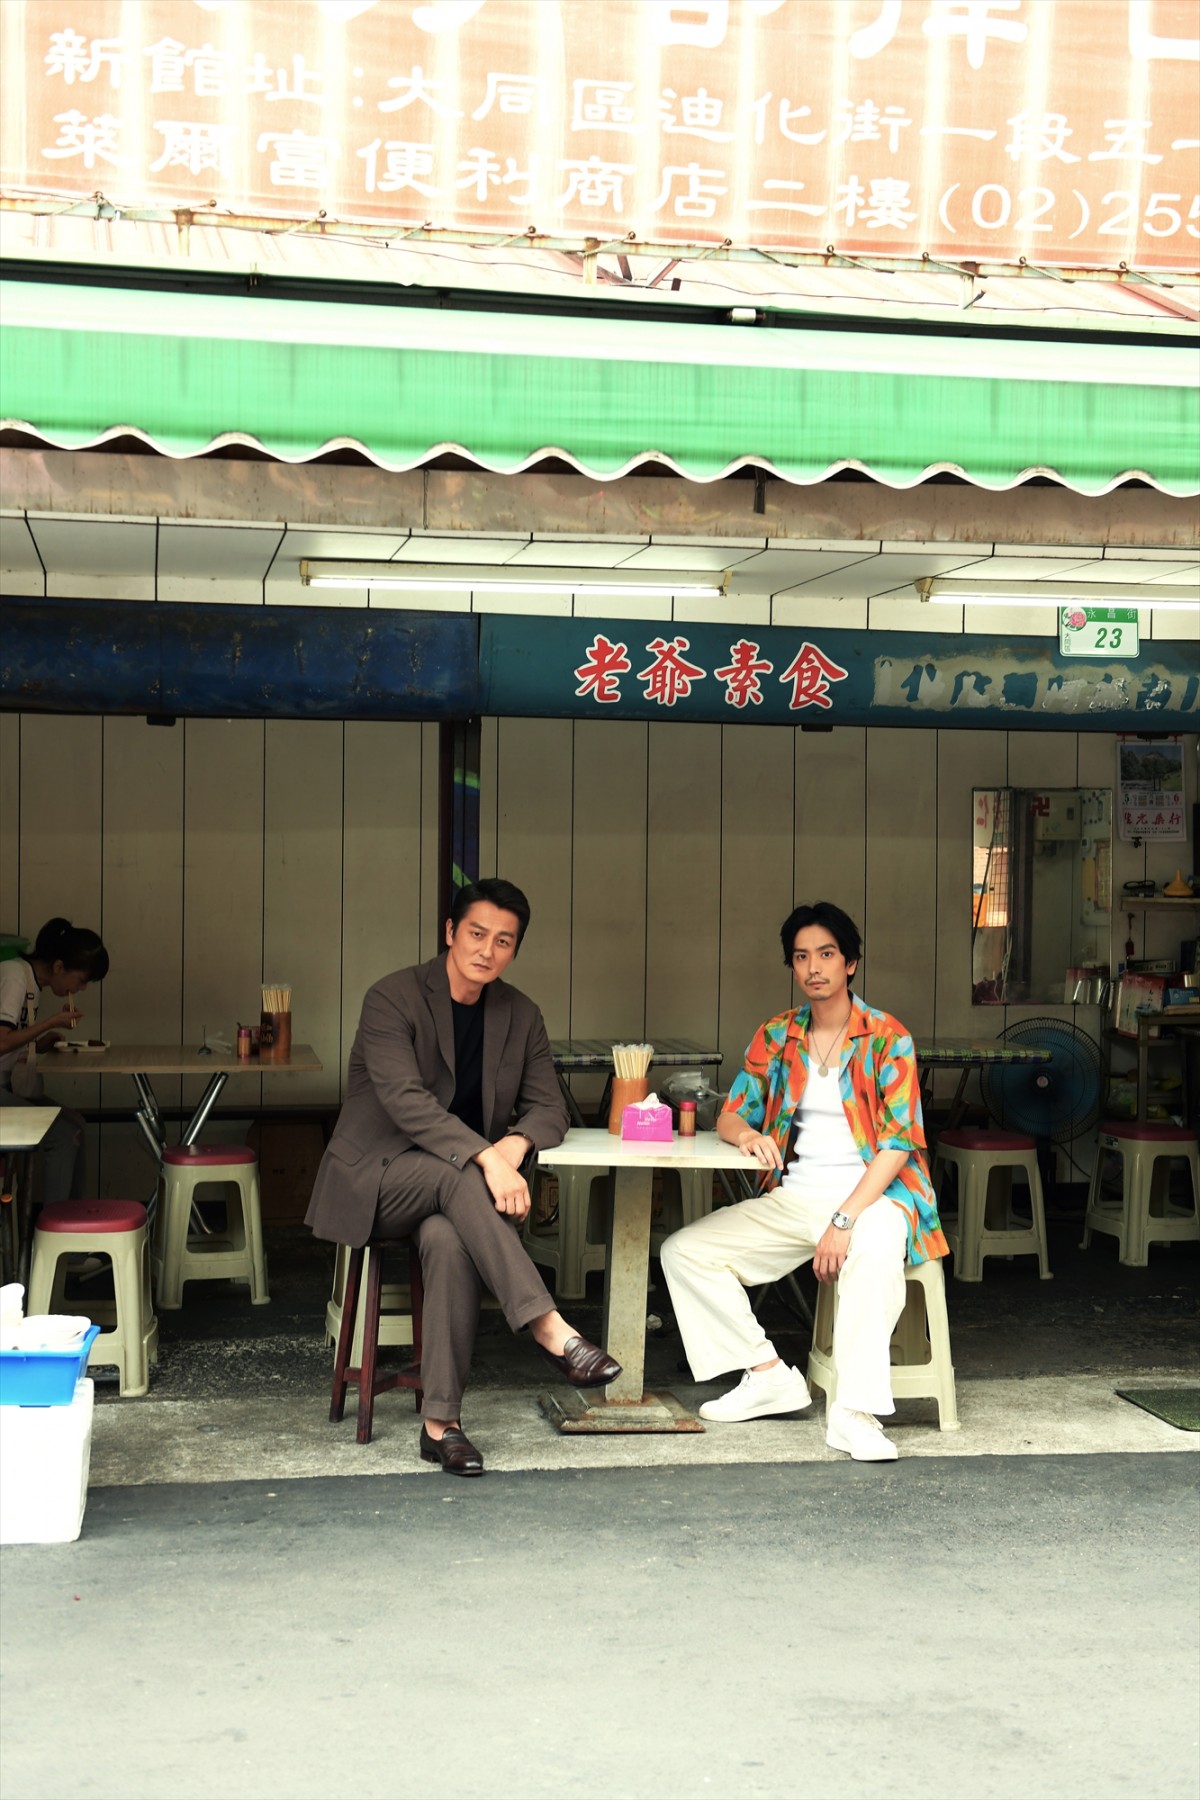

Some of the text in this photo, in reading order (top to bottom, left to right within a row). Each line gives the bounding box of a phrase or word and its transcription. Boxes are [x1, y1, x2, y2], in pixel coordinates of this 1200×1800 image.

[1087, 607, 1136, 620] 永昌街
[1095, 627, 1123, 649] 23
[573, 634, 849, 710] 老爺素食
